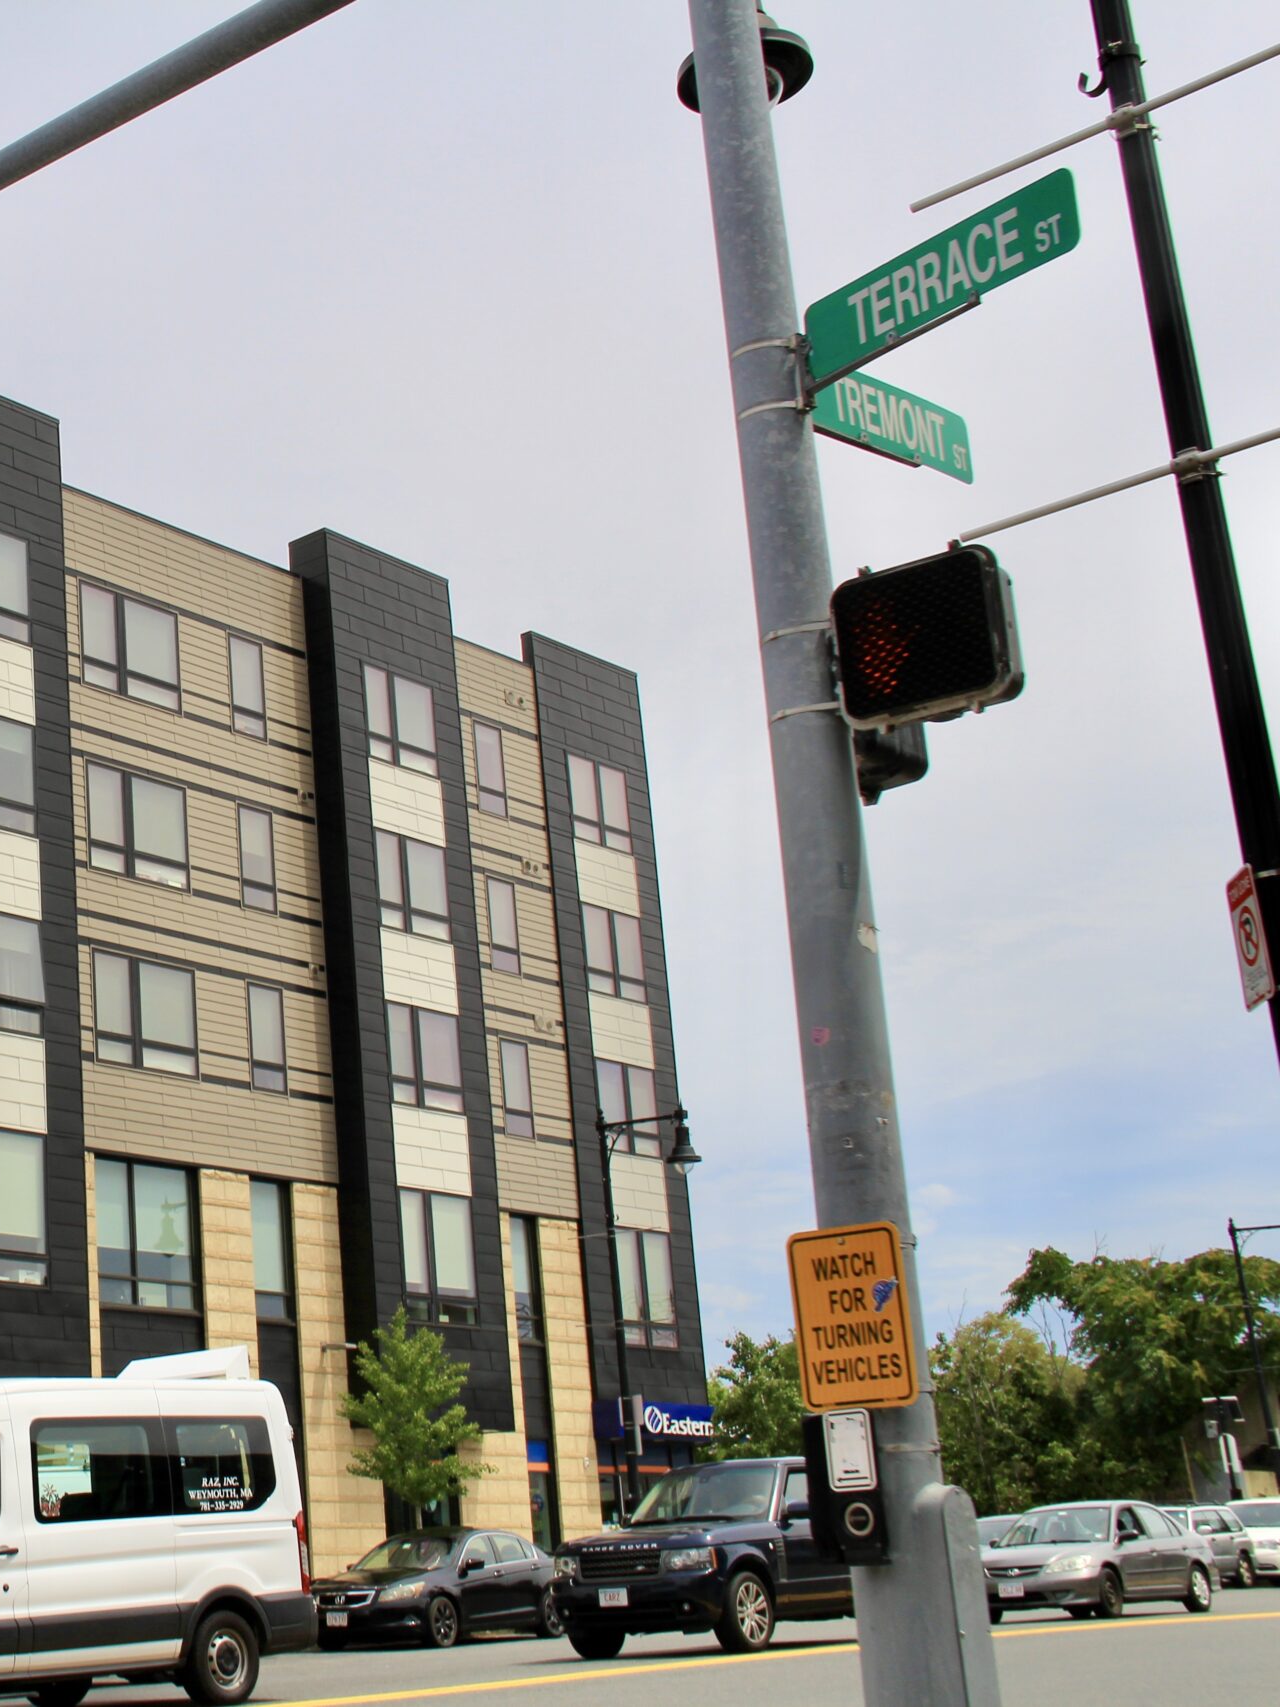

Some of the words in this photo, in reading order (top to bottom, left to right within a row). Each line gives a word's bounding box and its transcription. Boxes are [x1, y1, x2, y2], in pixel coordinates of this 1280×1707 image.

[848, 207, 1024, 344] TERRACE
[1034, 213, 1061, 253] ST
[834, 377, 945, 462] TREMONT
[952, 444, 968, 471] ST
[811, 1251, 877, 1282] WATCH
[828, 1287, 867, 1315] FOR
[812, 1319, 894, 1351] TURNING
[812, 1353, 903, 1386] VEHICLES
[662, 1412, 714, 1436] Eastern
[188, 1488, 238, 1500] WEYMOUTH,
[240, 1487, 253, 1498] MA
[201, 1477, 221, 1488] RAZ,
[224, 1476, 239, 1487] INC.
[200, 1500, 244, 1511] 781-335-2929
